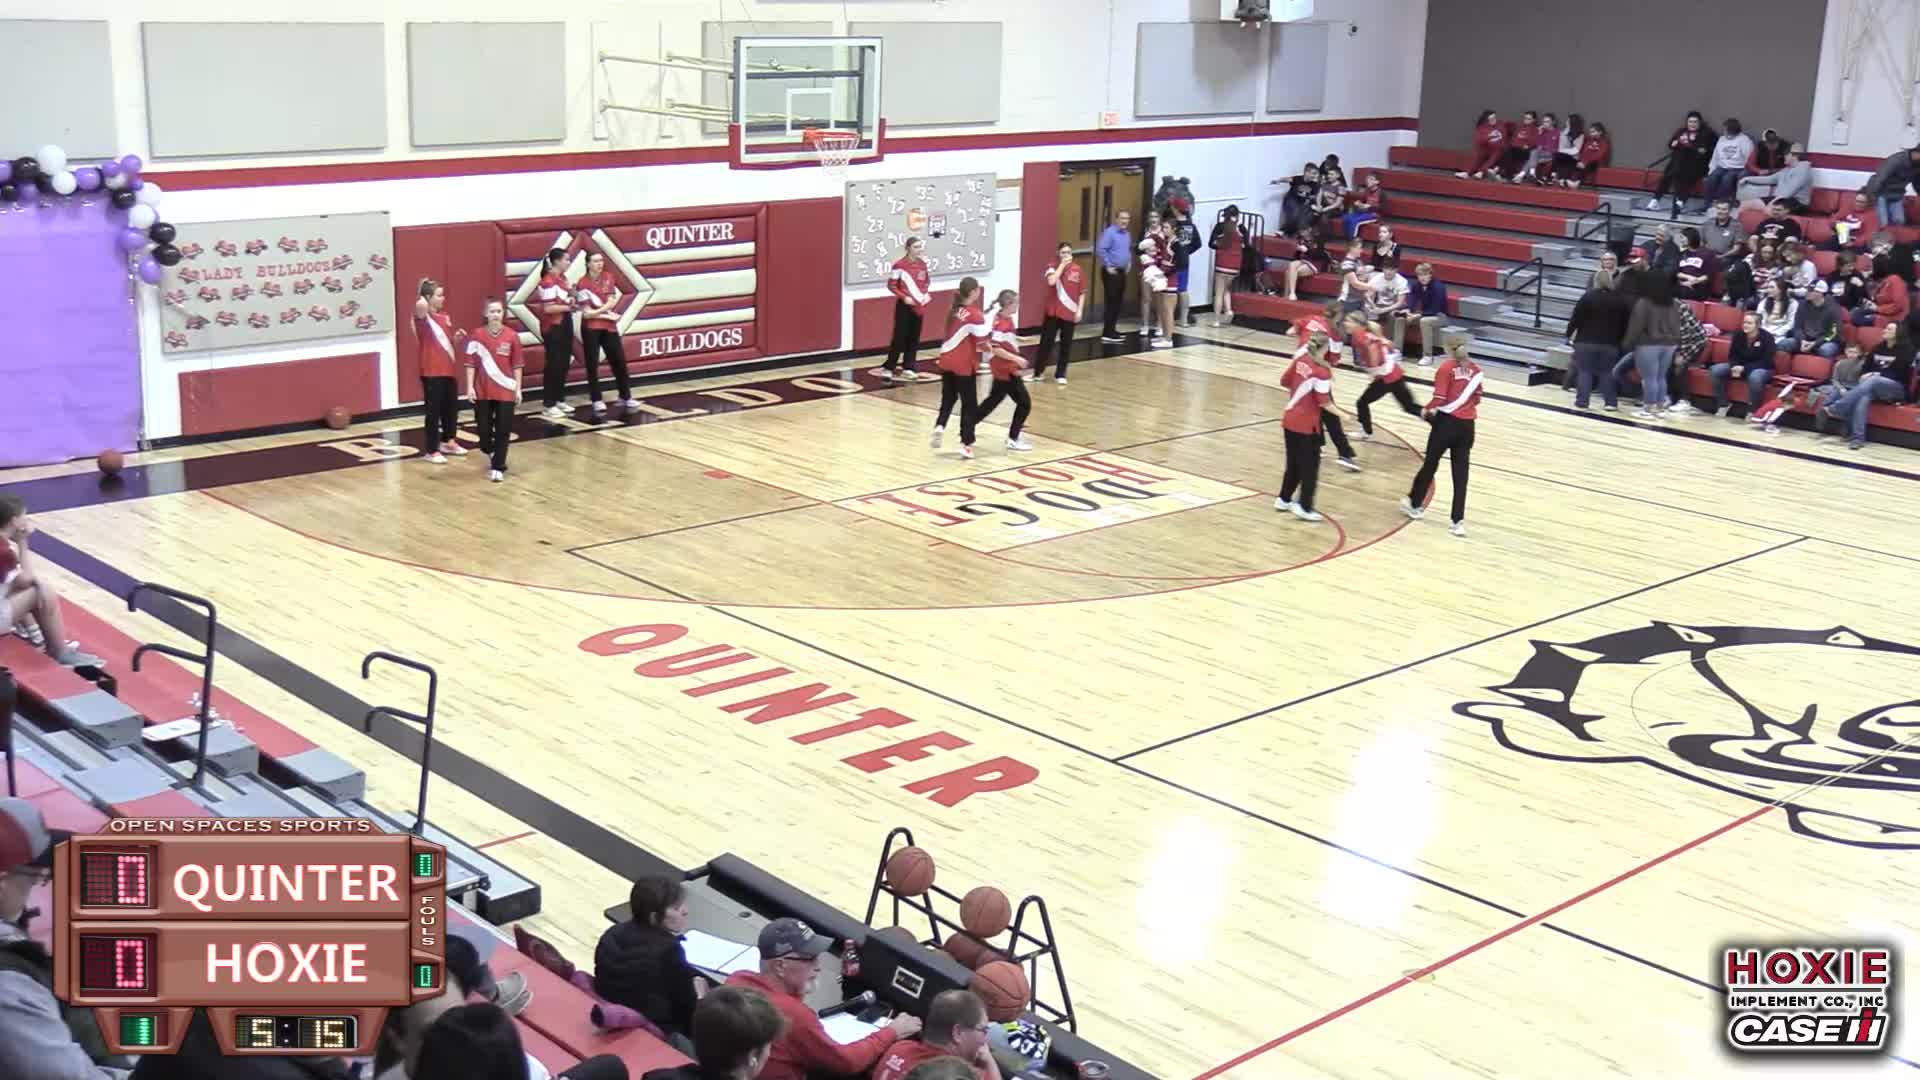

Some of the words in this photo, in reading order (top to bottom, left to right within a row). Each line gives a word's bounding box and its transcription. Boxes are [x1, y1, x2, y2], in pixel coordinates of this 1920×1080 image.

[646, 222, 735, 248] QUINTER
[201, 266, 243, 280] LADY
[256, 261, 331, 278] BULLDOGS
[640, 328, 743, 357] BULLDOGS
[857, 456, 1177, 528] HOUSE
[955, 478, 1168, 527] DOG
[577, 623, 1040, 808] QUINTER
